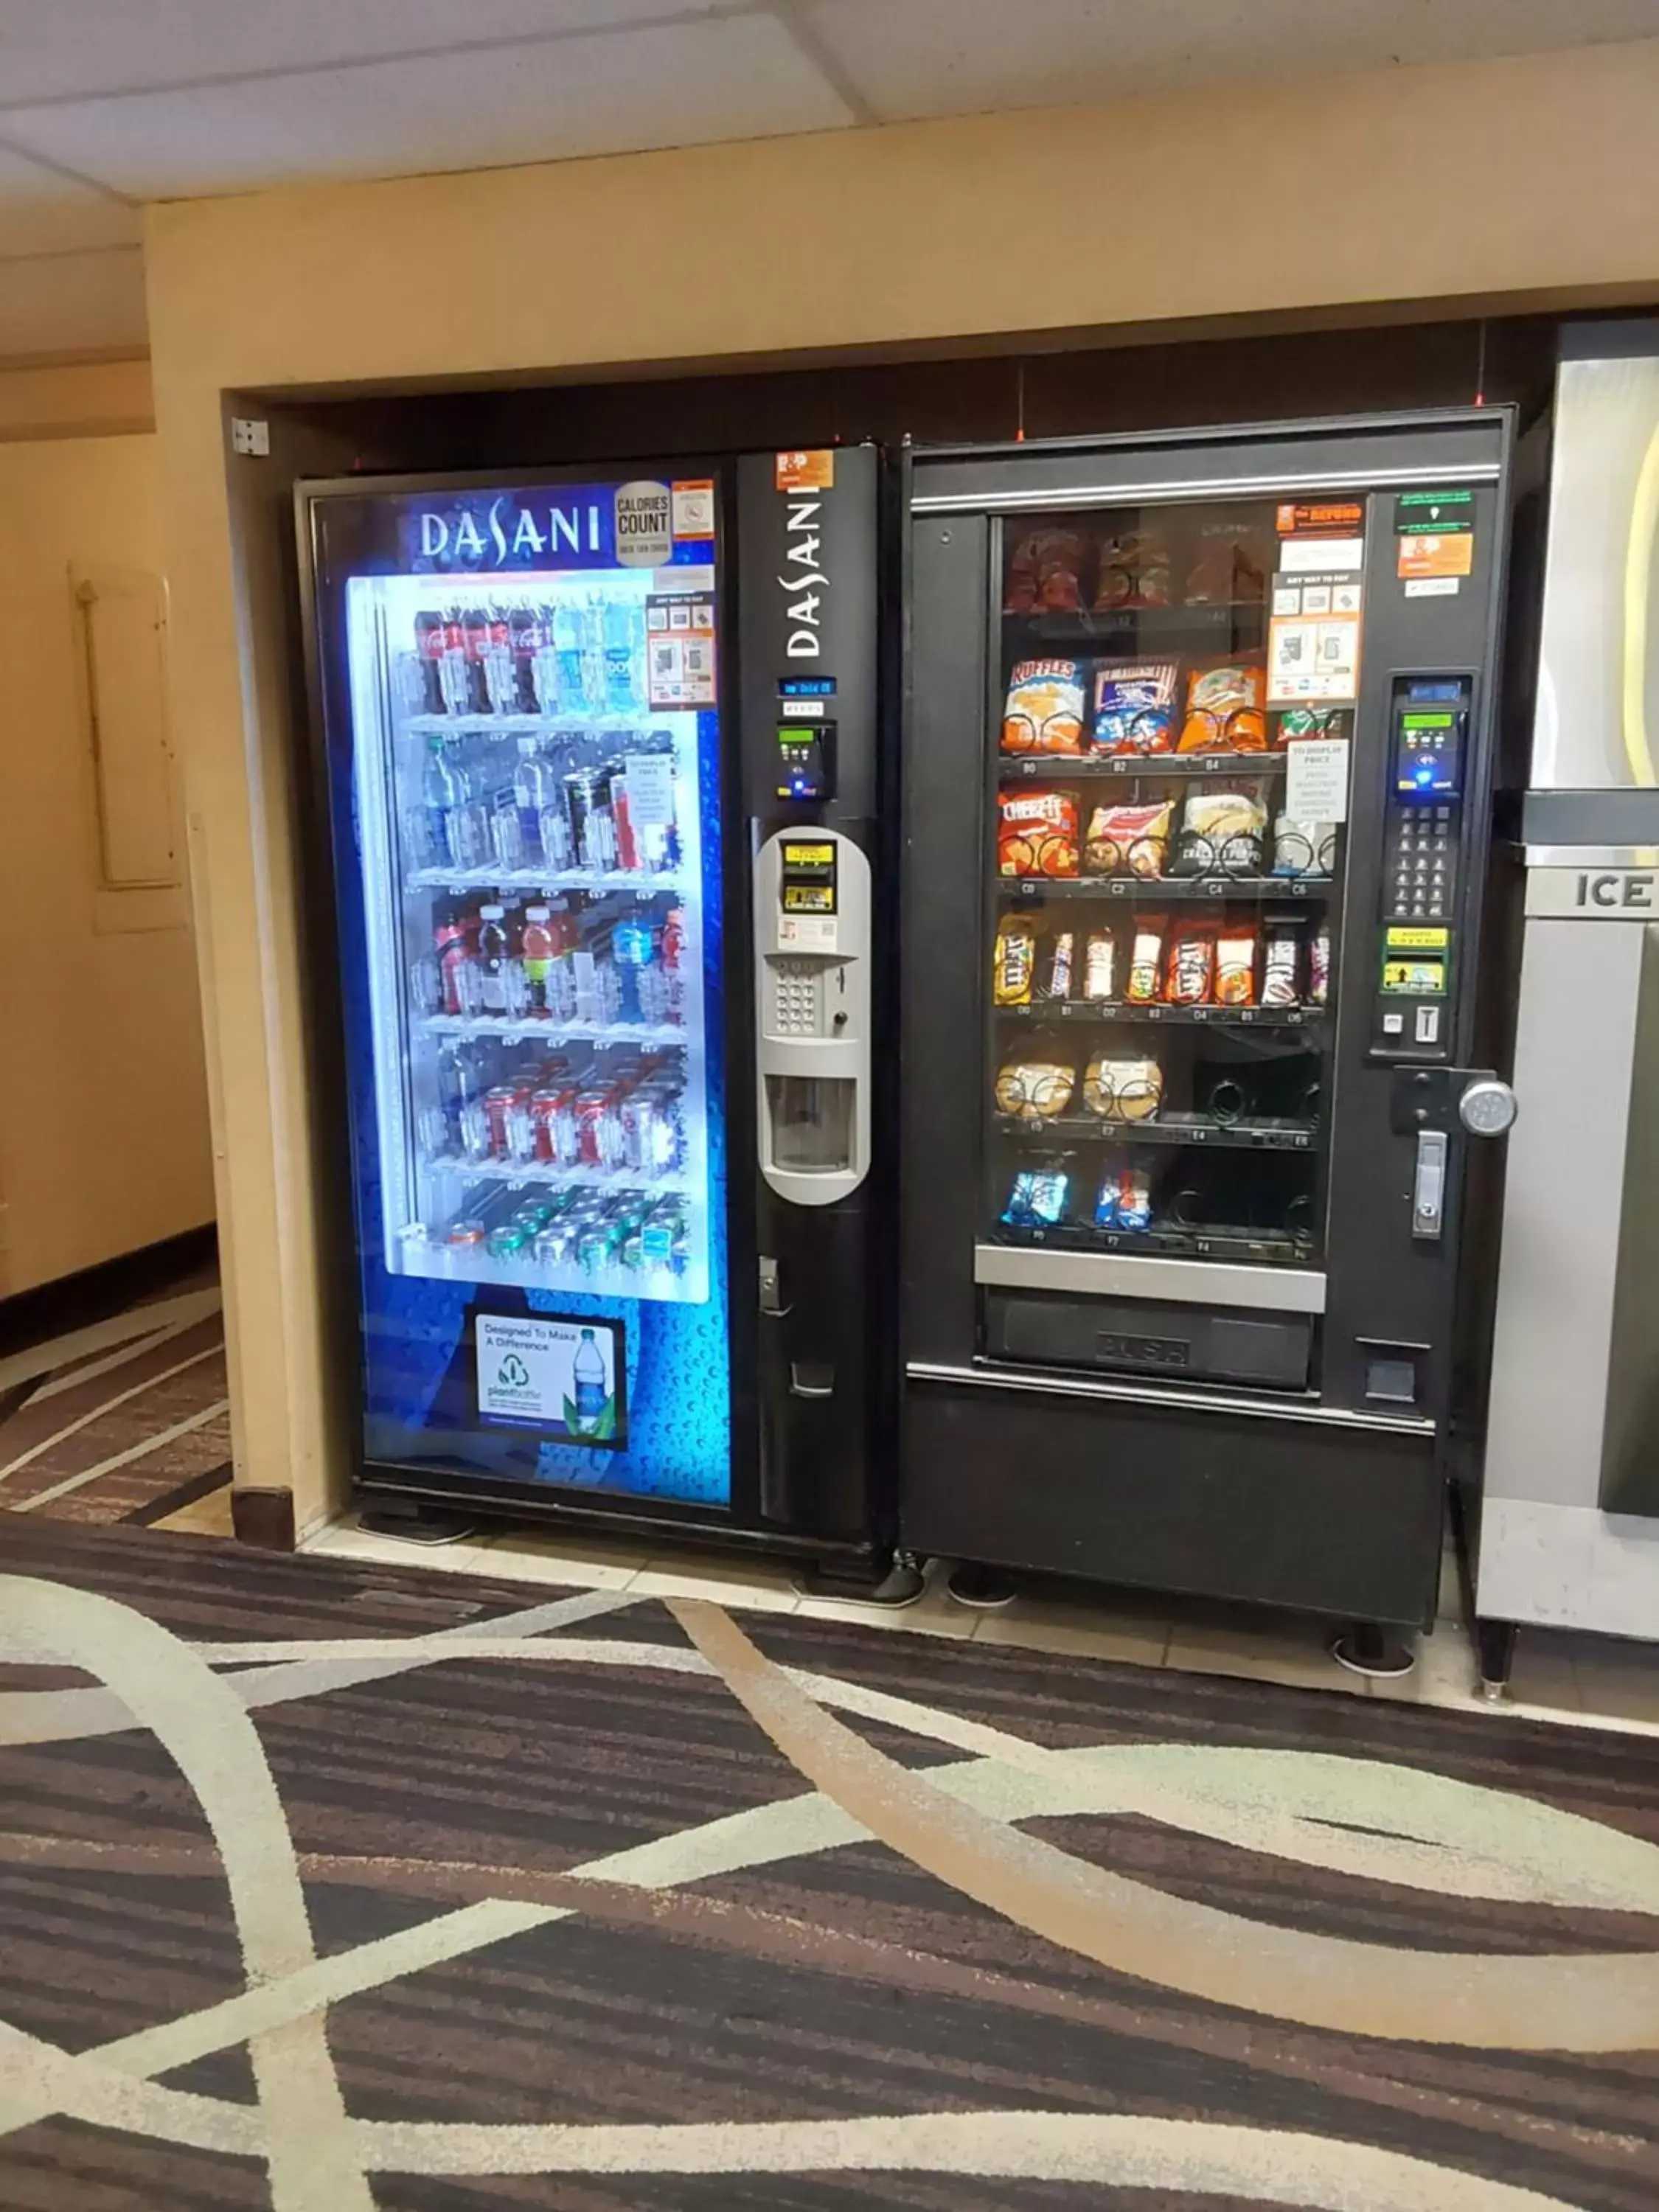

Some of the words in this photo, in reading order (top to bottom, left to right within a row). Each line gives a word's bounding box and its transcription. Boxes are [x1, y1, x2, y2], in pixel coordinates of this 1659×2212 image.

[618, 495, 667, 512] CALORIES
[422, 496, 599, 566] DASANI
[619, 512, 667, 535] COUNT
[777, 486, 830, 658] DASANI
[1011, 659, 1076, 686] RUFFLES
[1111, 885, 1125, 894] C2
[1208, 884, 1223, 895] C4
[1576, 873, 1654, 908] ICE
[1192, 1130, 1206, 1141] E4
[484, 1324, 532, 1338] Designed
[535, 1329, 546, 1338] To
[549, 1330, 577, 1341] Make
[487, 1337, 495, 1346] A
[496, 1339, 549, 1351] Difference
